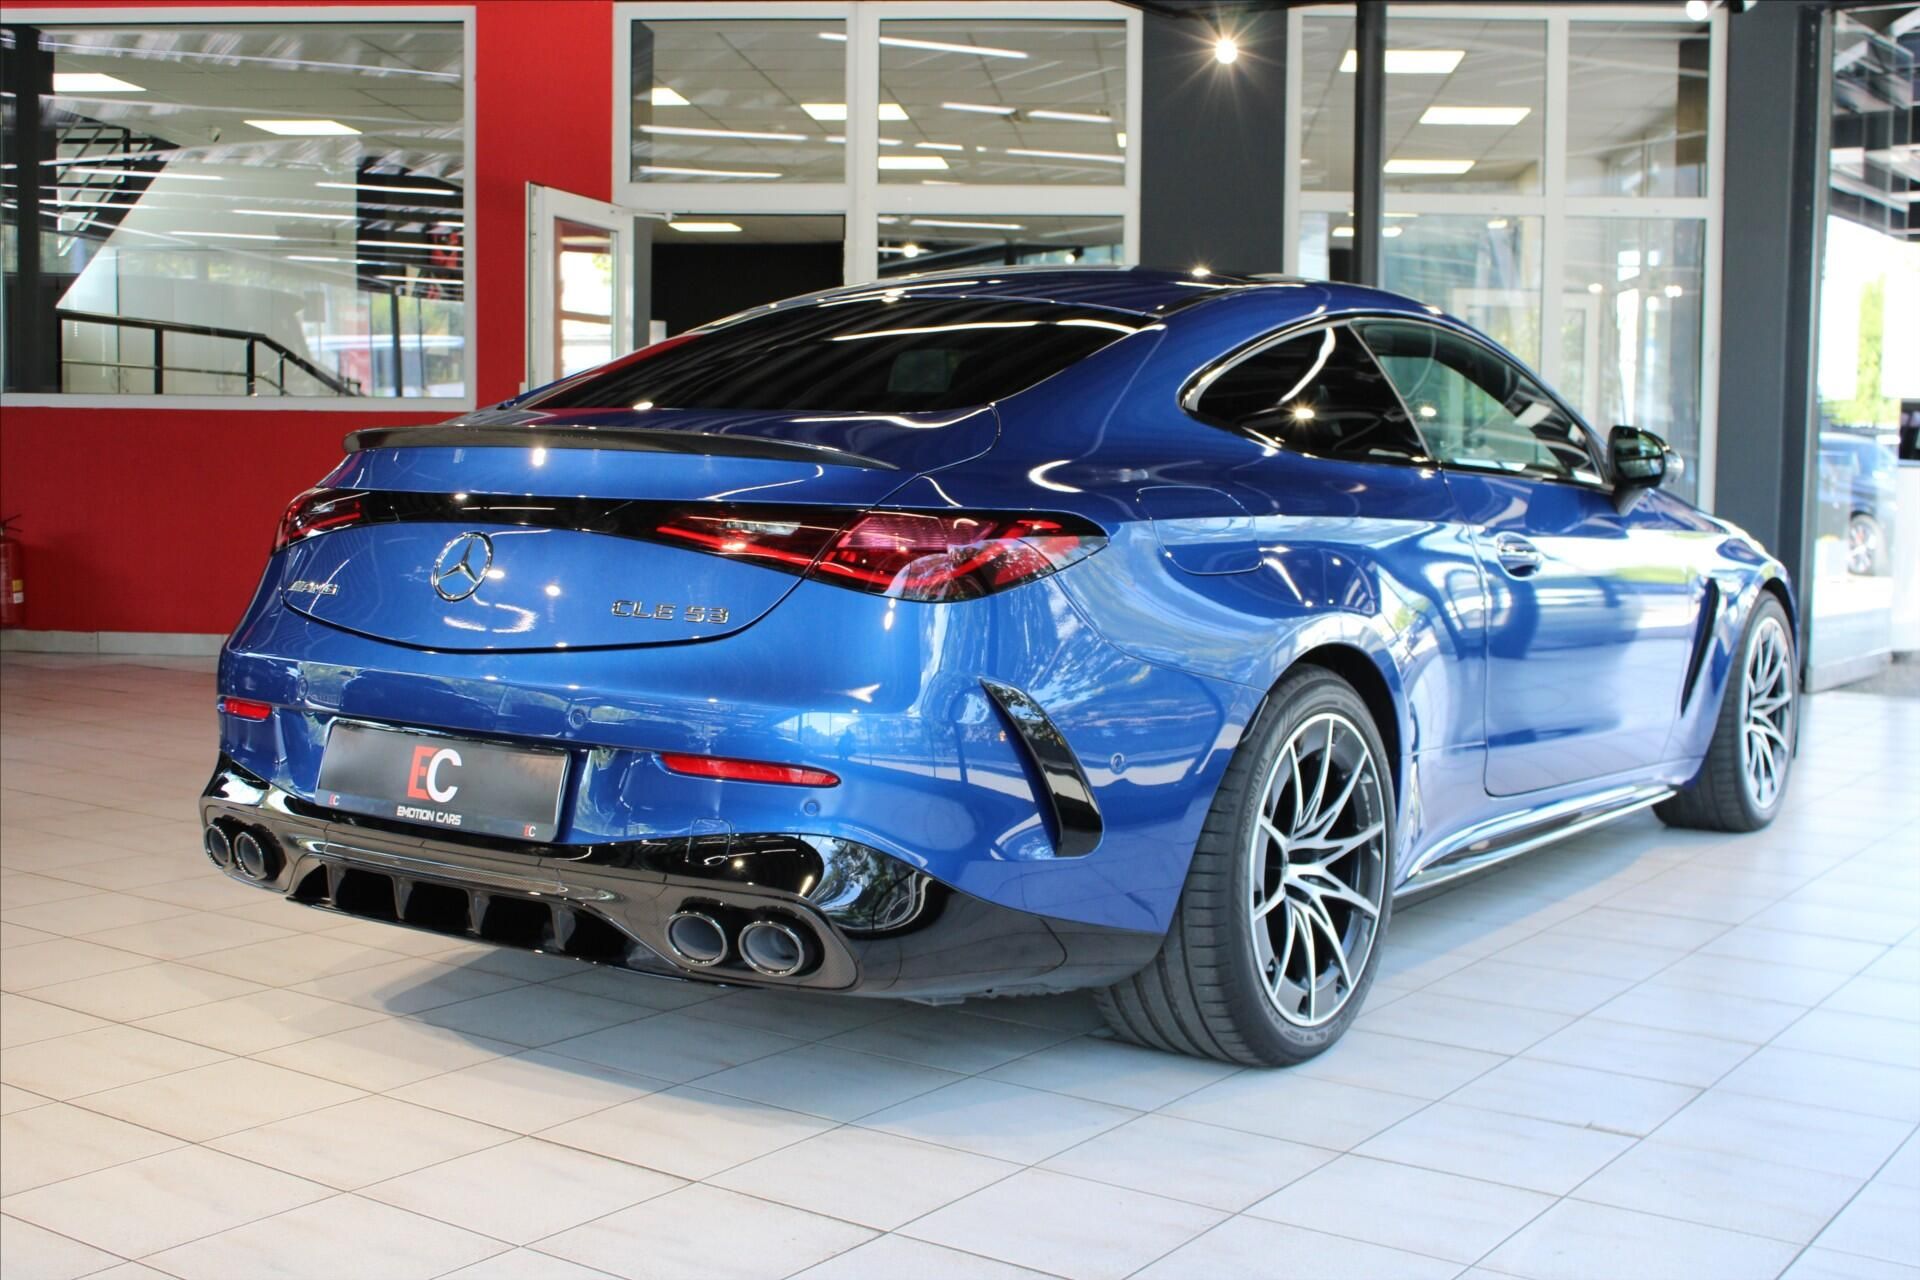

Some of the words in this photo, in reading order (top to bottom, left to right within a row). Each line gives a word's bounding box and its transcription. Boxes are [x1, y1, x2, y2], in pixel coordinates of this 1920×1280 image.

[611, 600, 676, 620] CLE
[684, 606, 729, 624] 53
[408, 745, 462, 803] EC
[396, 805, 435, 822] EMOTION
[436, 811, 462, 826] CARS
